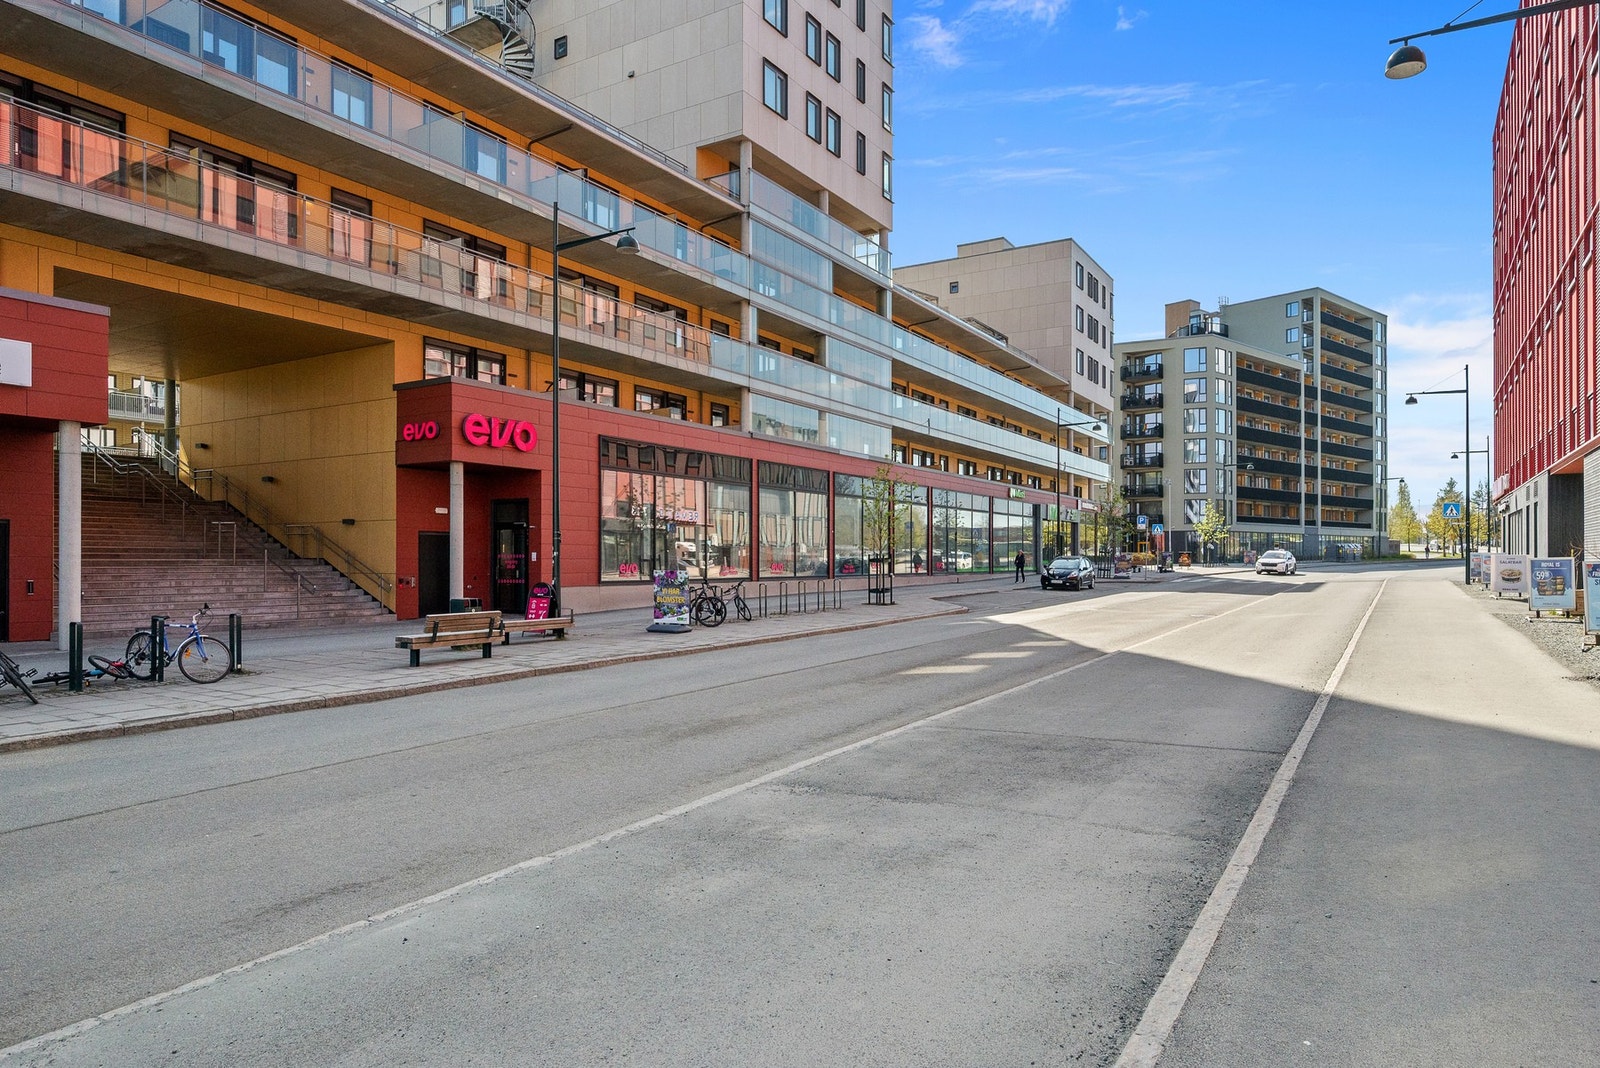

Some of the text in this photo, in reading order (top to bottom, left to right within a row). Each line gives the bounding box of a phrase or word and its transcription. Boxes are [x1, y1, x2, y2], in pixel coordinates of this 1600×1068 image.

[402, 420, 438, 441] evo
[463, 413, 537, 452] evo
[619, 563, 639, 574] evo
